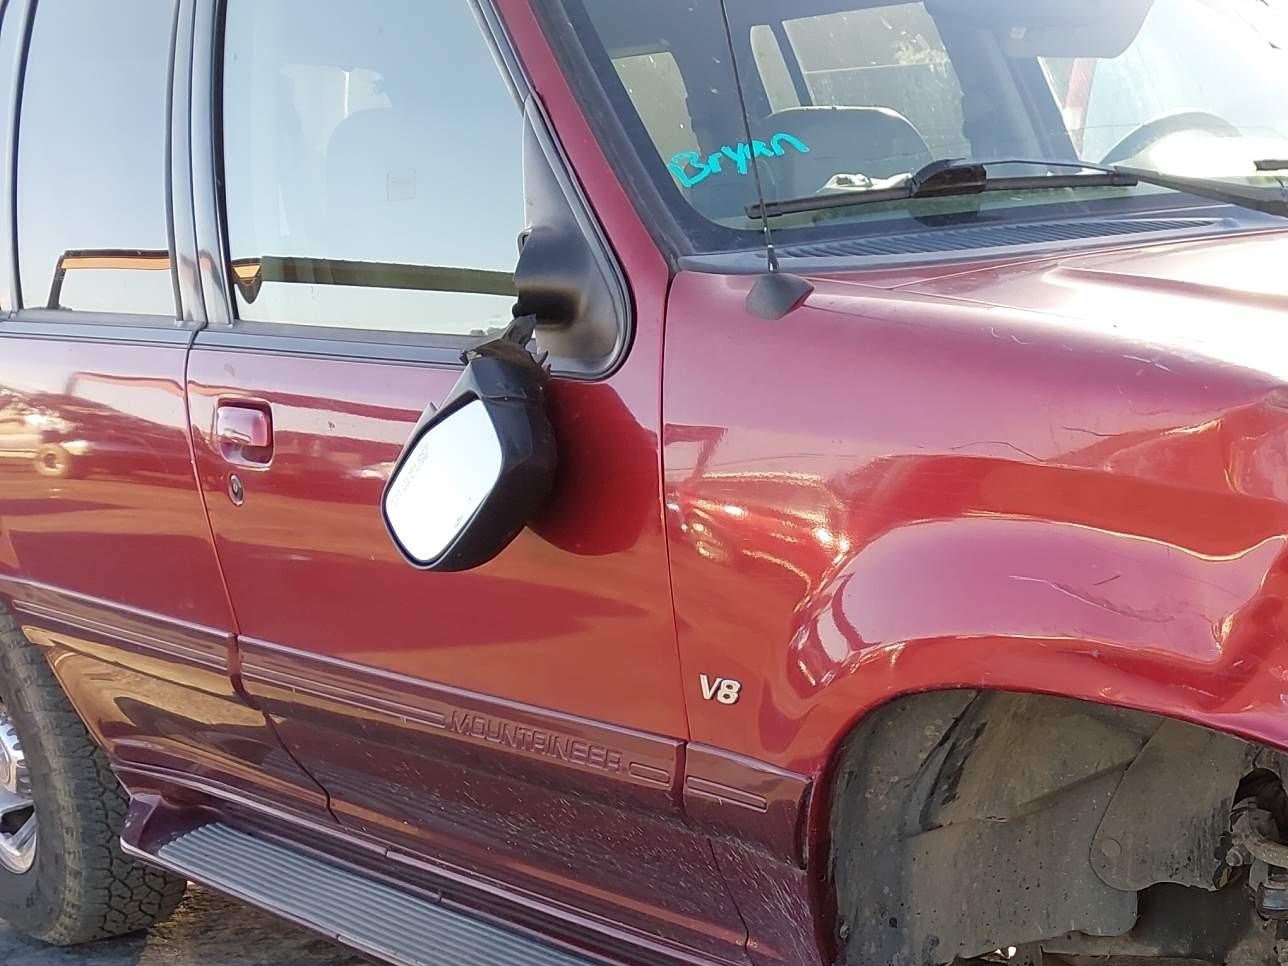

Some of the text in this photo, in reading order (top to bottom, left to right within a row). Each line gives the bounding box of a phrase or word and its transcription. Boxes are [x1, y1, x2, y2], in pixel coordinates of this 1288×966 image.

[668, 132, 810, 188] Bryan
[699, 673, 741, 705] V8
[451, 709, 625, 774] MOUNTAINEER
